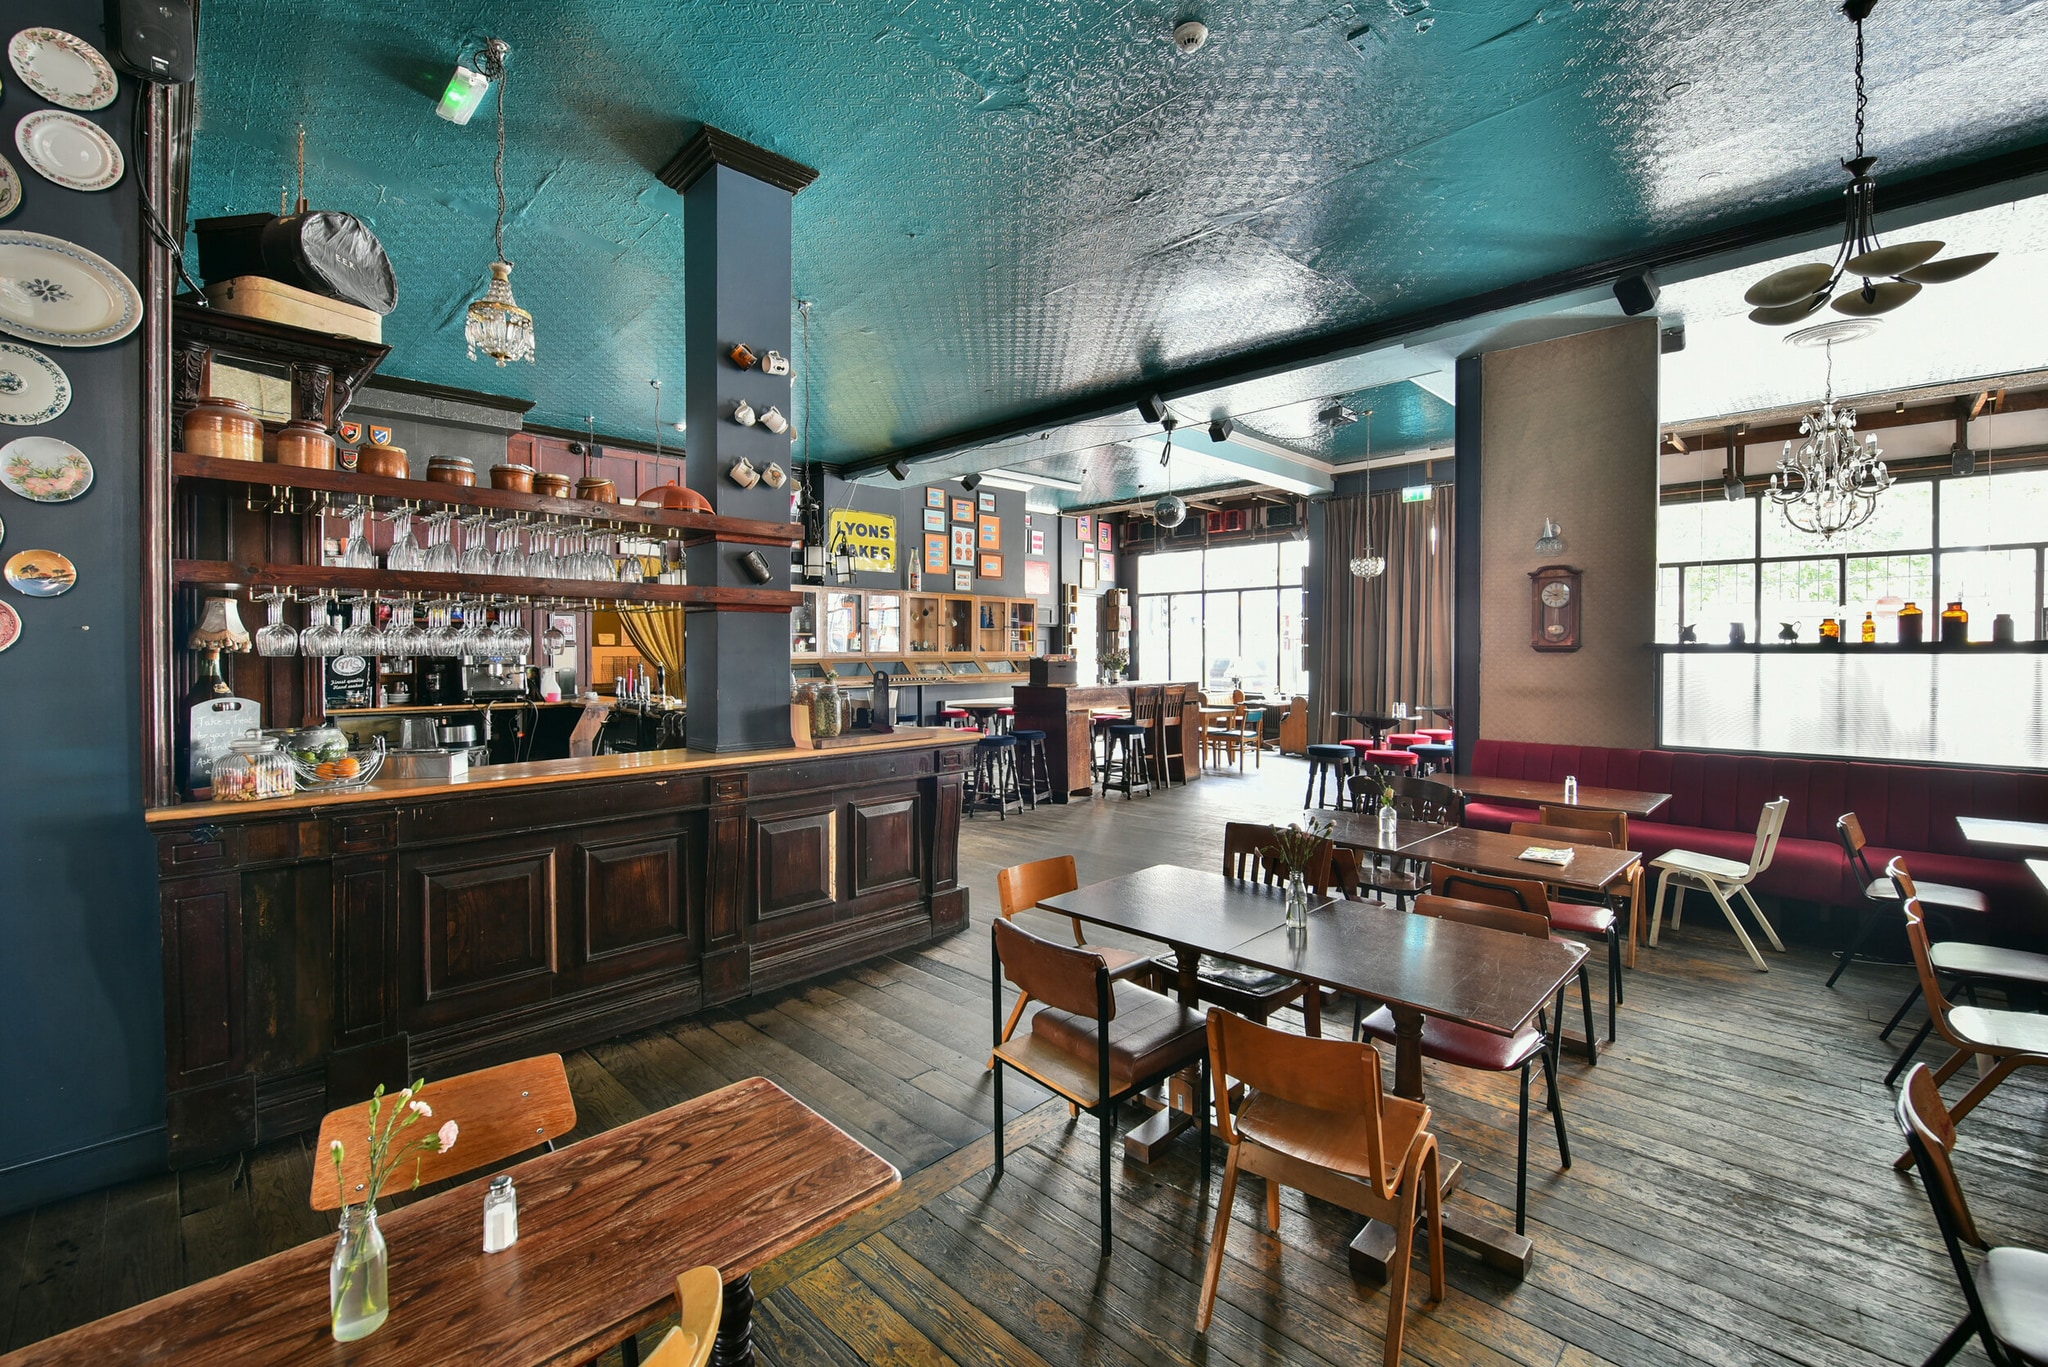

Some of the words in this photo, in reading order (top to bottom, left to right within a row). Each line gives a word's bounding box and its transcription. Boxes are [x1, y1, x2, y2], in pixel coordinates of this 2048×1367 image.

[197, 716, 223, 728] Take
[196, 731, 209, 741] for
[209, 730, 226, 743] your
[196, 757, 212, 768] Ask
